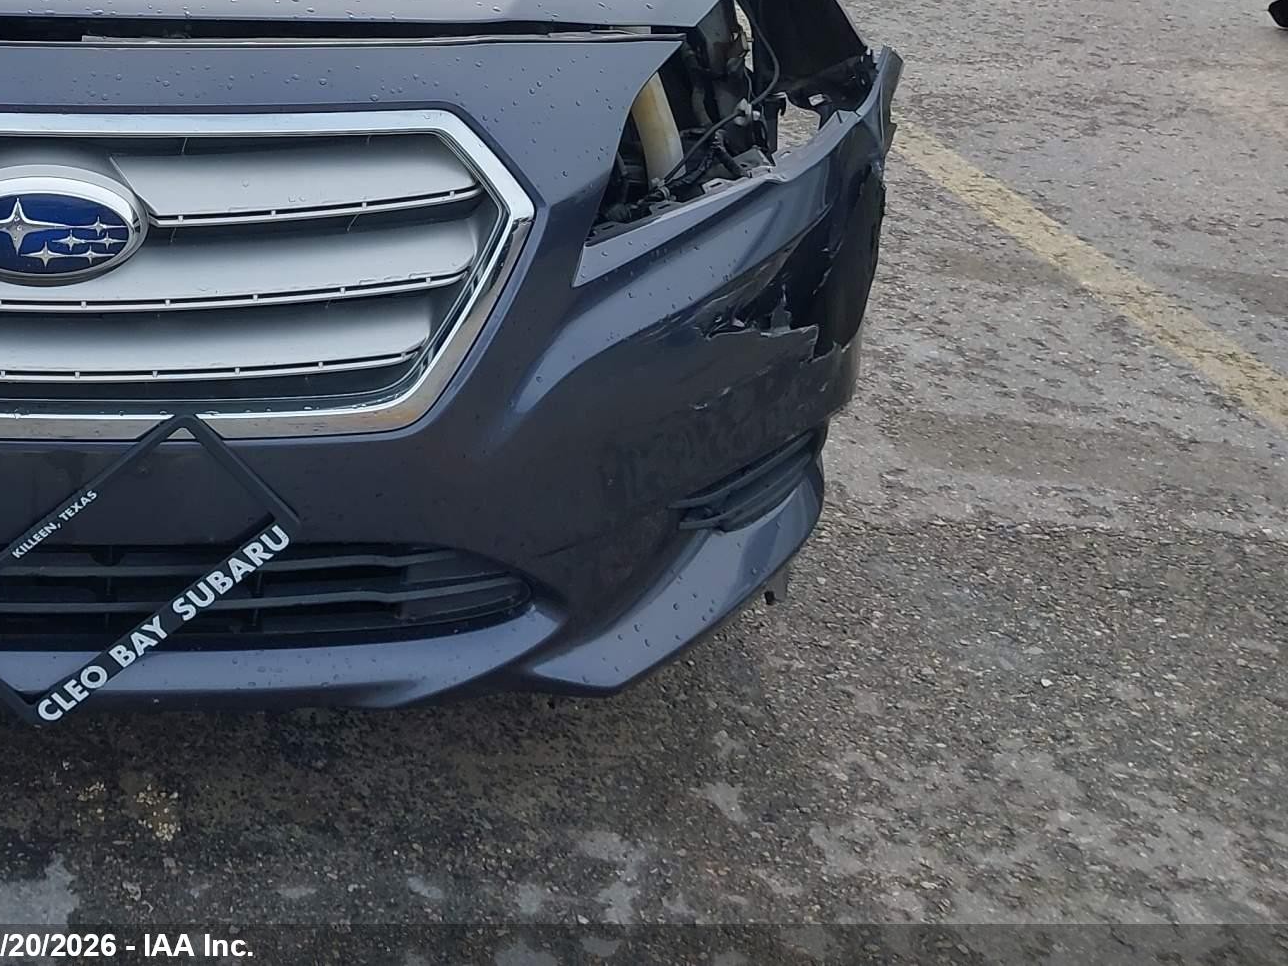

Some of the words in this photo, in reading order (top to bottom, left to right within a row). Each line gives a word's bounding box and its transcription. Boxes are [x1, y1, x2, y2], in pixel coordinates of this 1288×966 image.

[13, 521, 61, 559] KILLEEN,
[59, 490, 98, 521] TEXAS
[37, 665, 108, 723] CLEO
[108, 616, 168, 668] BAY
[172, 525, 291, 622] SUBARU
